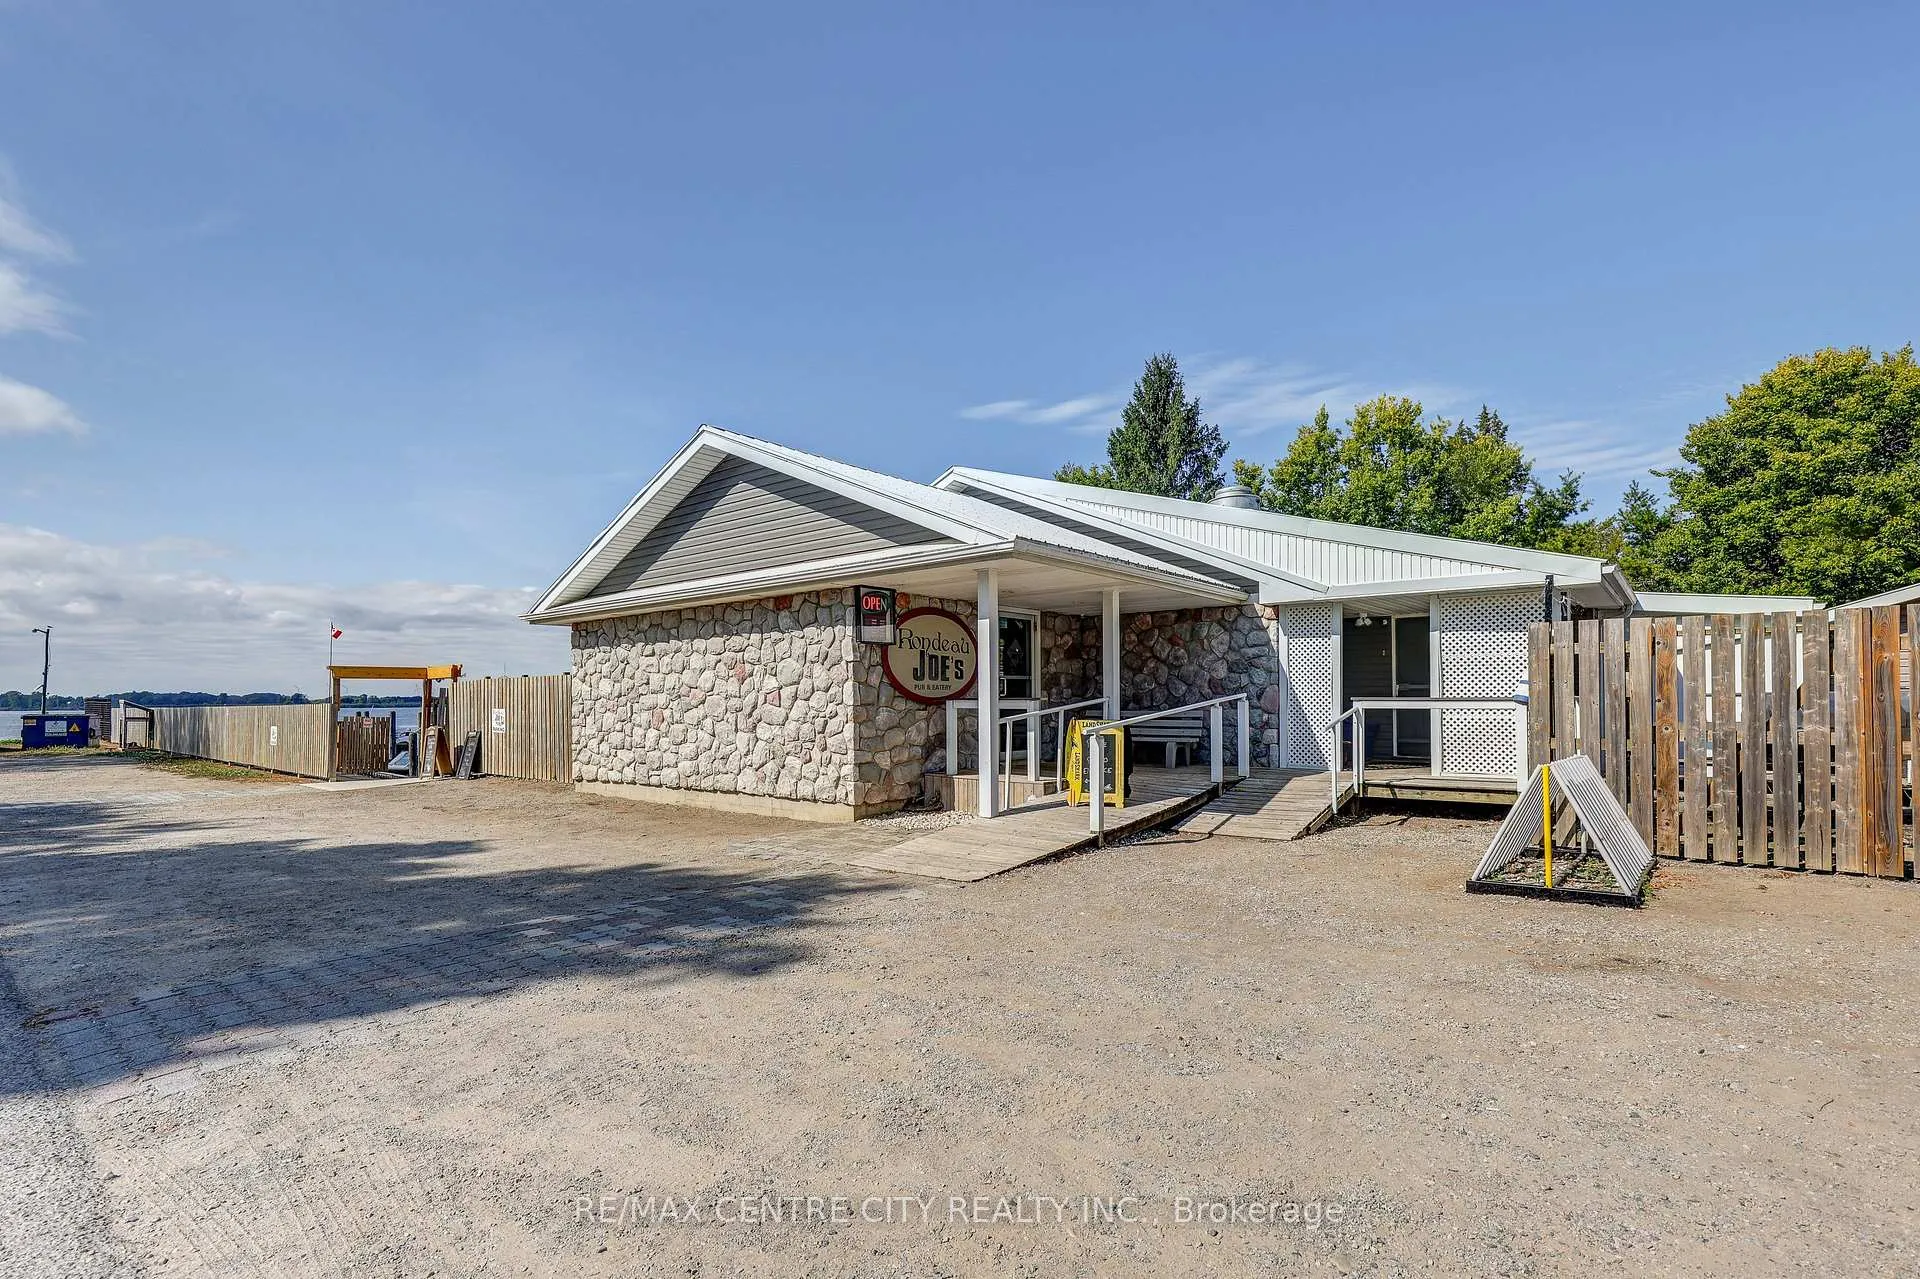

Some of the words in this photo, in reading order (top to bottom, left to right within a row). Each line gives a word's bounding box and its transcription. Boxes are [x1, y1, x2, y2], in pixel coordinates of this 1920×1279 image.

[862, 595, 887, 611] OPEN
[898, 627, 970, 656] Rondeau
[913, 649, 964, 682] JOE'S
